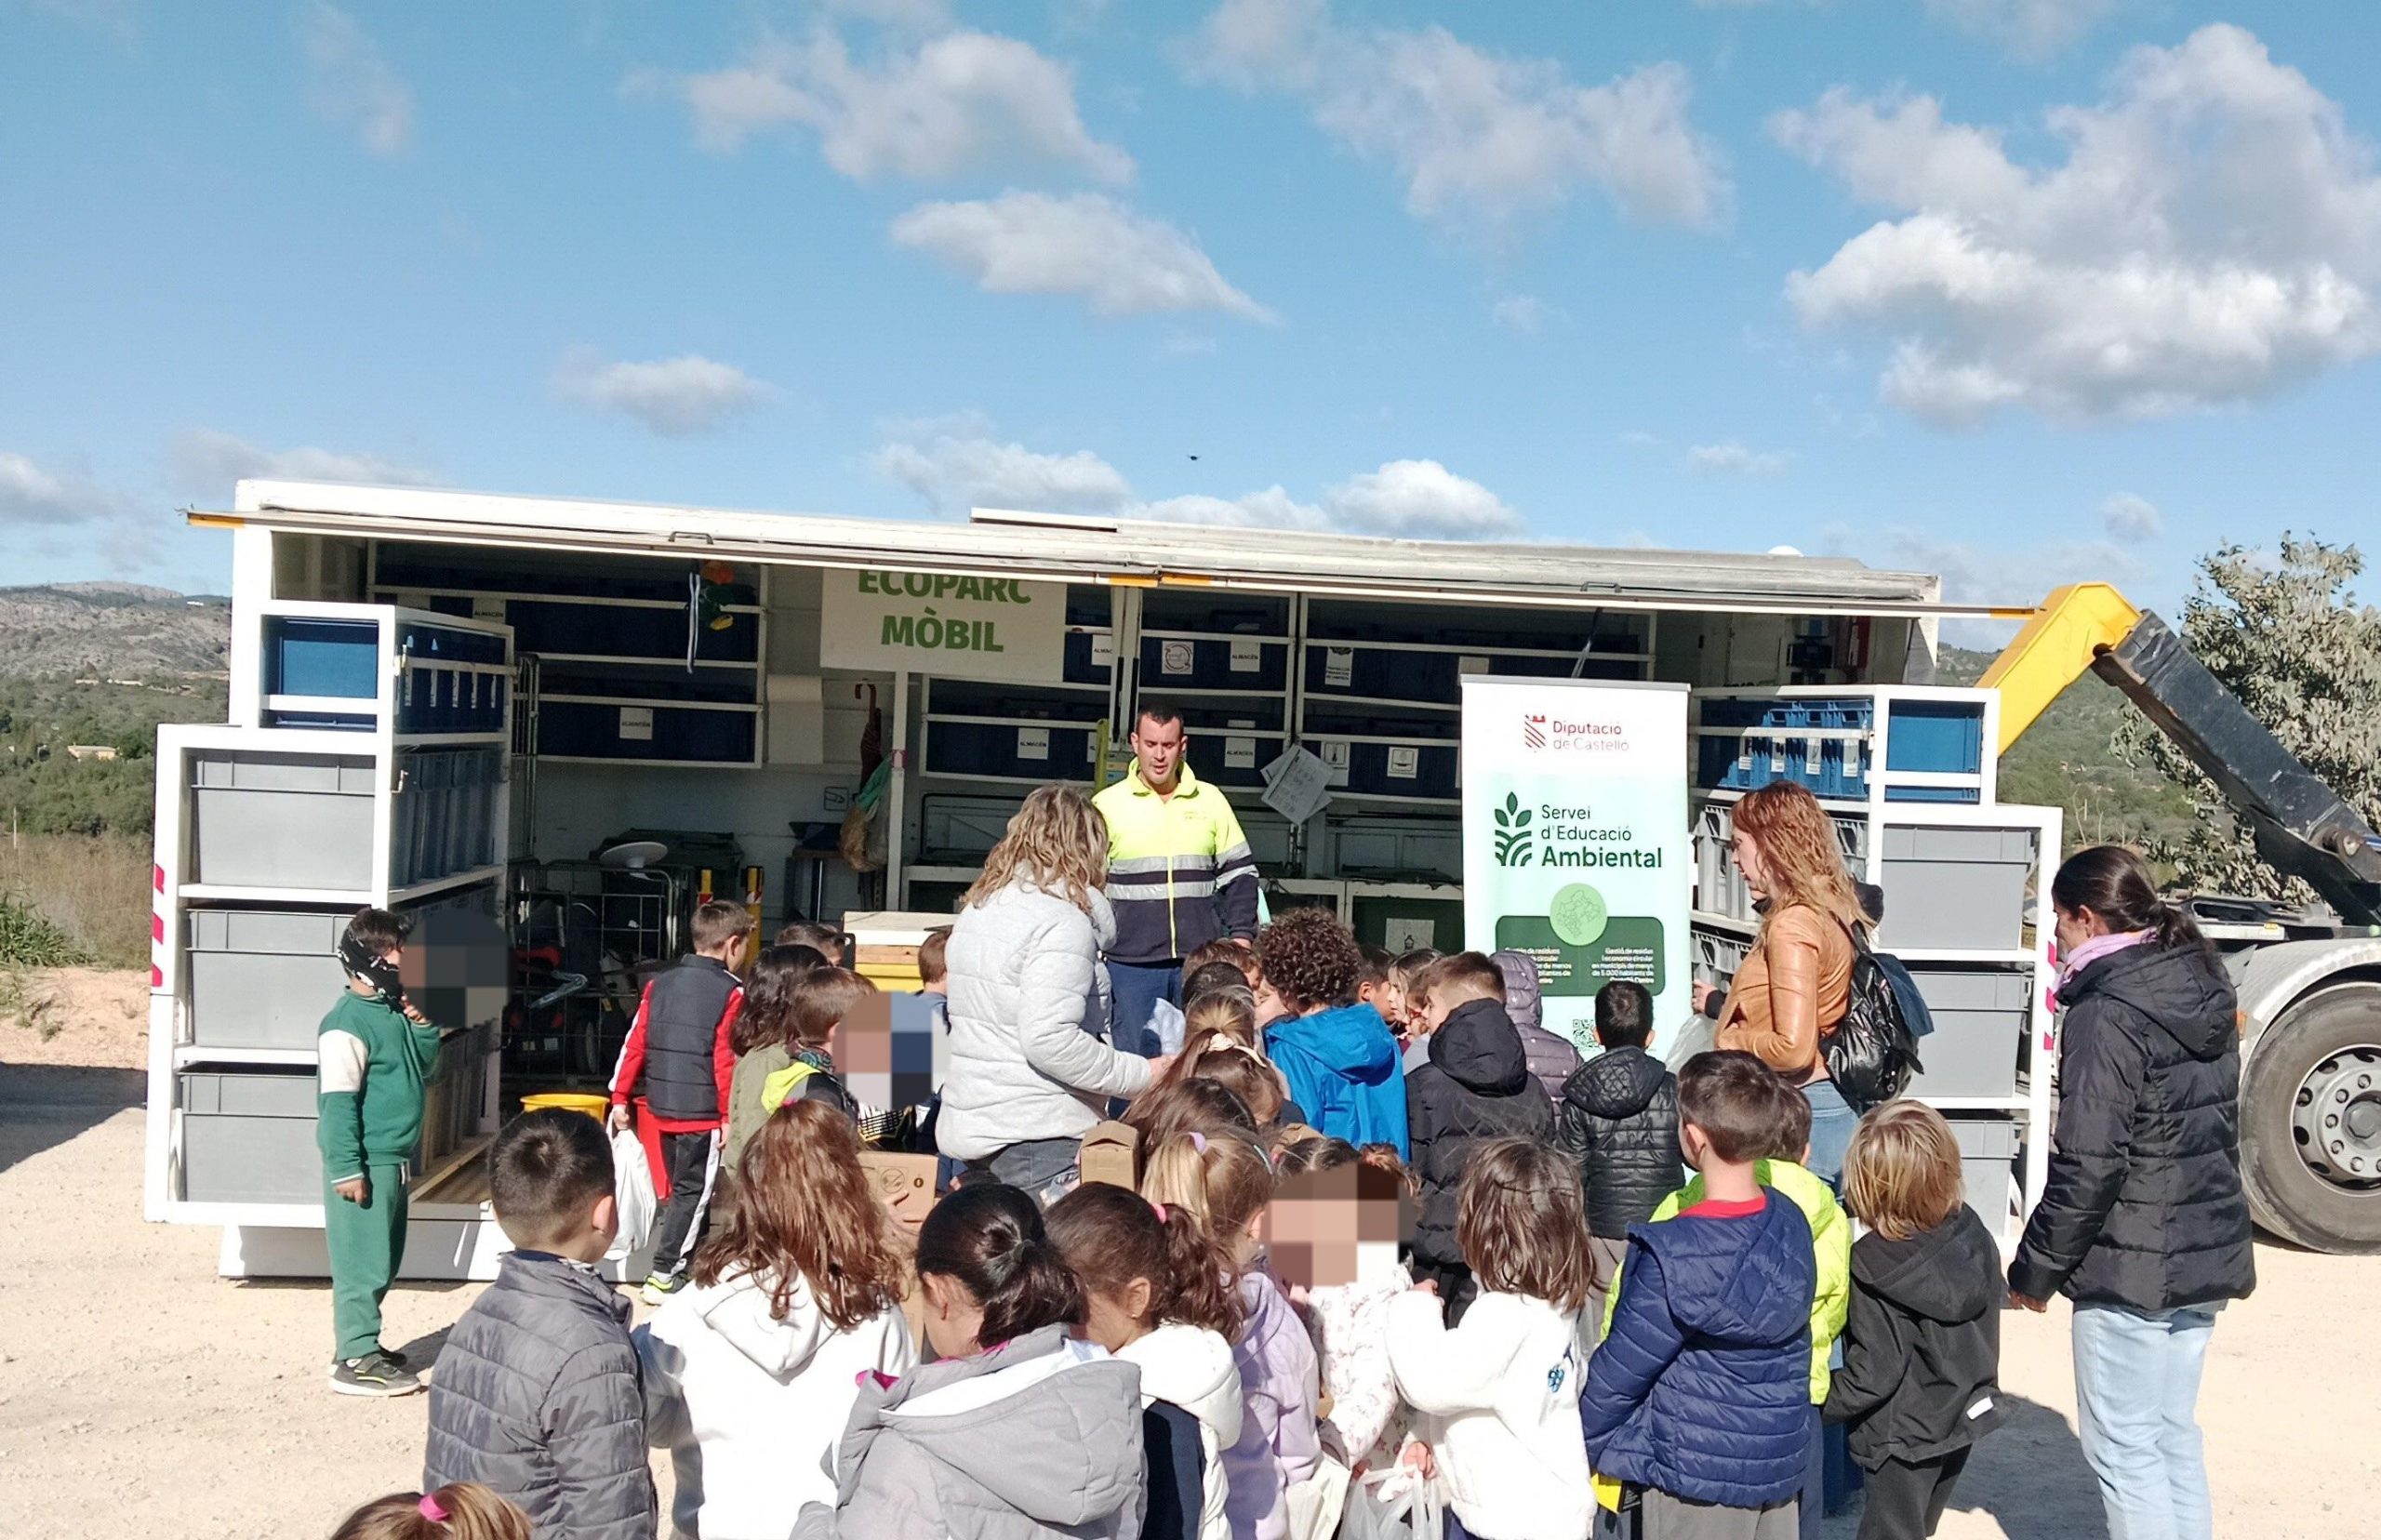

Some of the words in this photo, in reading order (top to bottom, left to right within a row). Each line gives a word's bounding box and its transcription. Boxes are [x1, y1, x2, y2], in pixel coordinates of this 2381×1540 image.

[858, 569, 1031, 604] ECOPARC
[881, 605, 1004, 653] MÒBIL
[1553, 720, 1622, 737] Diputació
[1553, 737, 1571, 750] de
[1574, 737, 1629, 751] Castelló
[1541, 803, 1590, 819] Servei
[1540, 825, 1631, 841] d'Educació
[1541, 845, 1662, 868] Ambiental
